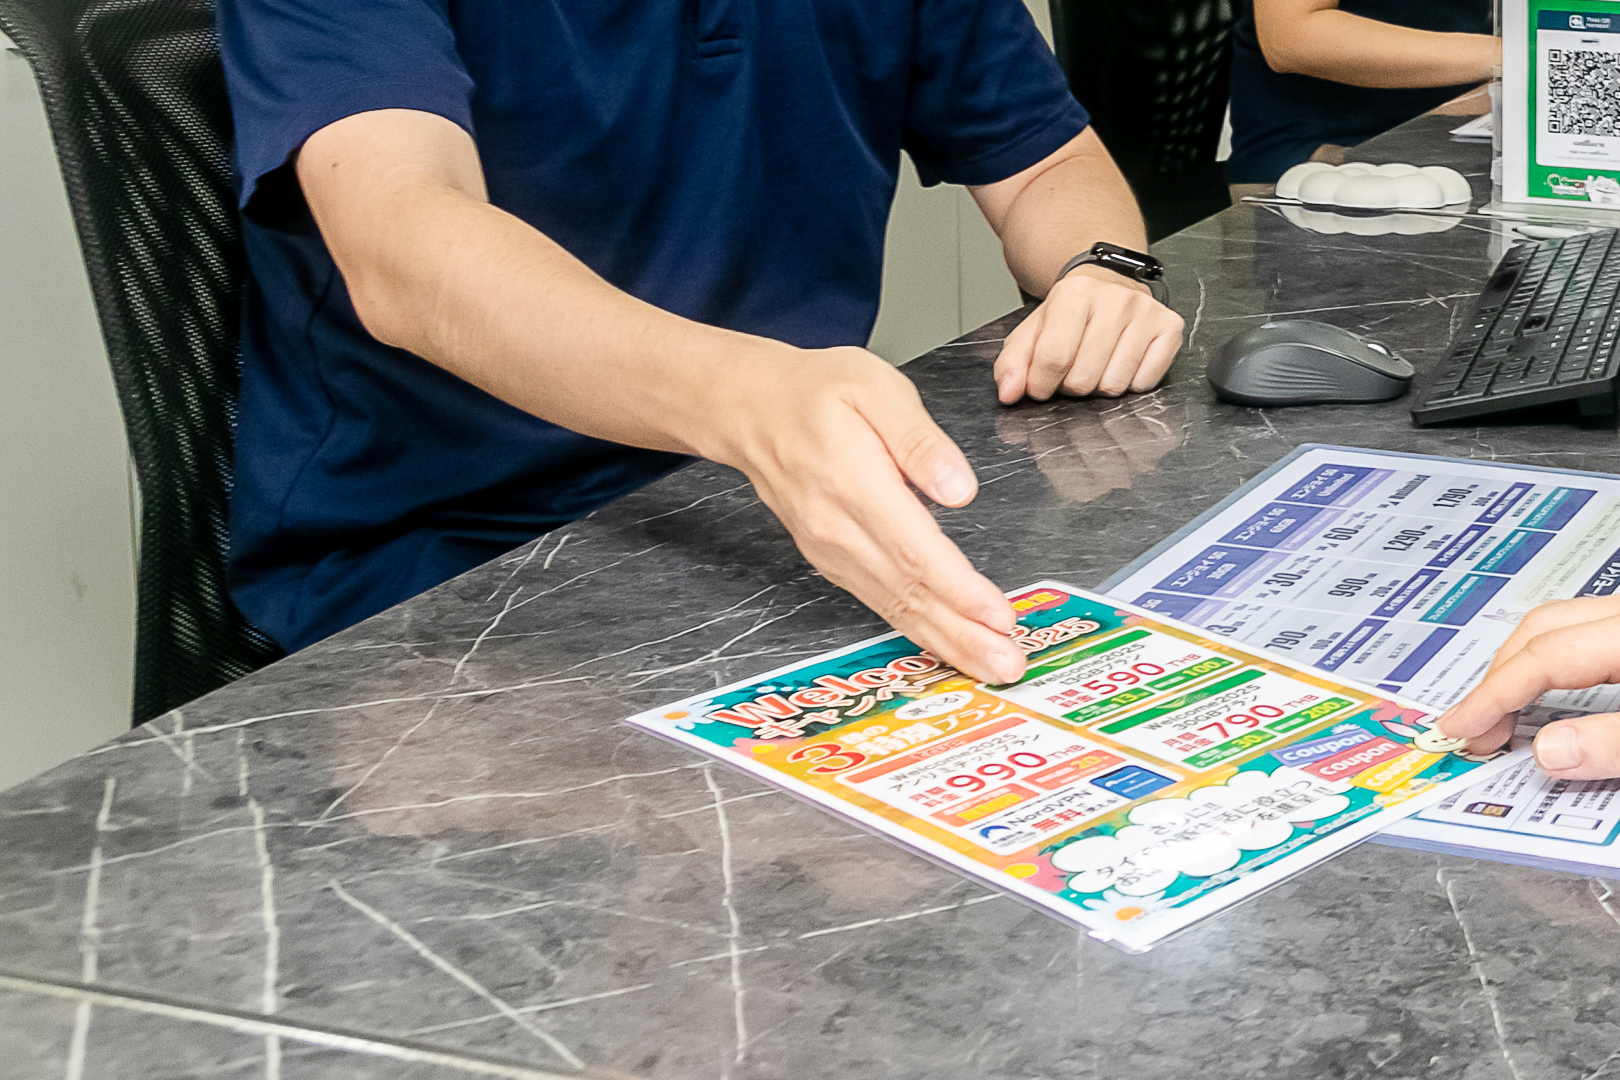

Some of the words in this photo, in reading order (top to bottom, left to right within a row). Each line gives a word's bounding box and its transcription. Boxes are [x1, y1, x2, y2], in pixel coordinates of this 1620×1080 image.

[1432, 489, 1472, 507] 1,790
[1382, 530, 1426, 551] 1,290
[1328, 578, 1369, 596] 990
[1264, 631, 1307, 650] 790
[750, 665, 964, 740] キャンペー
[999, 616, 1104, 653] 025
[1027, 644, 1145, 687] Welcome2025
[1059, 654, 1141, 685] 13GBプラン
[1081, 662, 1166, 694] 590
[1166, 654, 1201, 666] THB
[1182, 661, 1221, 676] 100
[1110, 692, 1140, 704] 13
[1143, 684, 1260, 730] Welcome2025
[1172, 695, 1258, 730] 30GBプラン
[1301, 701, 1342, 718] 200
[856, 697, 1013, 756] 特別プラン
[1197, 704, 1285, 738] 790
[1283, 694, 1319, 708] THB
[908, 738, 967, 761] true
[1231, 734, 1264, 748] 30
[1282, 734, 1370, 760] coupon
[784, 742, 871, 775] 3
[889, 734, 1041, 791] アンリミテッドプラン
[890, 734, 1017, 781] Welcome2025
[944, 751, 1048, 792] 990
[1046, 744, 1085, 759] THB
[1069, 755, 1105, 769] 20
[1319, 743, 1396, 775] coupon
[1364, 749, 1428, 786] coupon
[1007, 790, 1092, 826] NordVPN
[1031, 809, 1083, 831] 無料
